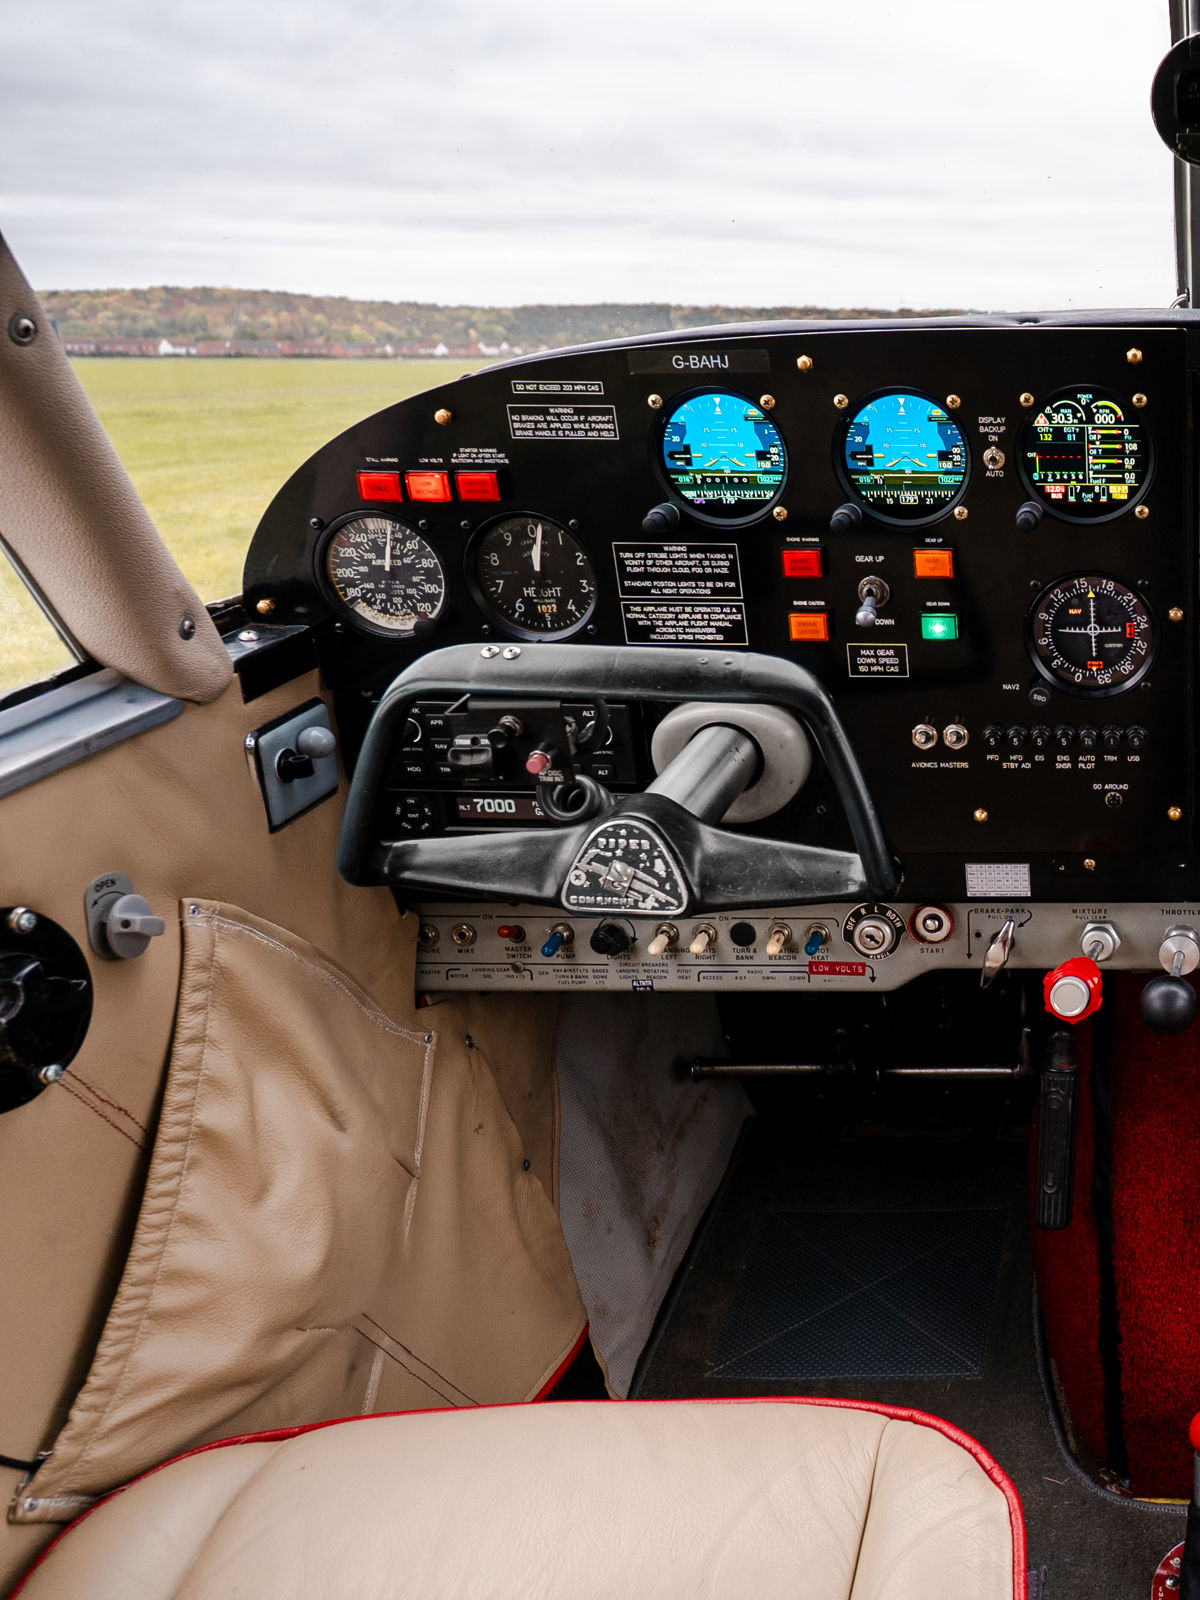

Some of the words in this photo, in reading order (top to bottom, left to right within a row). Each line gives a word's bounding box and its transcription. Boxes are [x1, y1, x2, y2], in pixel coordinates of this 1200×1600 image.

[672, 355, 729, 369] G-BAHJ
[1051, 414, 1073, 424] 30.3
[1095, 414, 1115, 424] 000
[528, 524, 536, 537] 0
[349, 533, 367, 543] 240
[503, 532, 512, 546] 9
[406, 541, 418, 550] 60
[340, 548, 355, 557] 220
[575, 552, 584, 565] 2
[421, 559, 434, 567] 80
[490, 553, 499, 566] 8
[337, 568, 354, 577] 200
[425, 584, 438, 593] 100
[496, 580, 504, 593] 7
[579, 580, 589, 593] 3
[1073, 578, 1088, 589] 15
[1101, 580, 1115, 591] 18
[347, 588, 361, 597] 180
[523, 587, 562, 597] HEGHT
[1050, 589, 1064, 602] 12
[1123, 592, 1138, 605] 21
[417, 603, 431, 612] 120
[515, 599, 524, 612] 6
[537, 604, 557, 613] 1022
[567, 599, 576, 611] 4
[1136, 615, 1149, 630] 24
[1136, 642, 1147, 656] 27
[1120, 661, 1134, 675] 30
[1097, 673, 1112, 685] 33
[473, 799, 516, 813] 7000
[597, 838, 650, 849] PIPER
[95, 879, 116, 892] OPEN
[846, 918, 856, 931] OFF
[886, 910, 902, 927] BOTH
[812, 964, 831, 973] LOW
[834, 965, 863, 973] VOLTS
